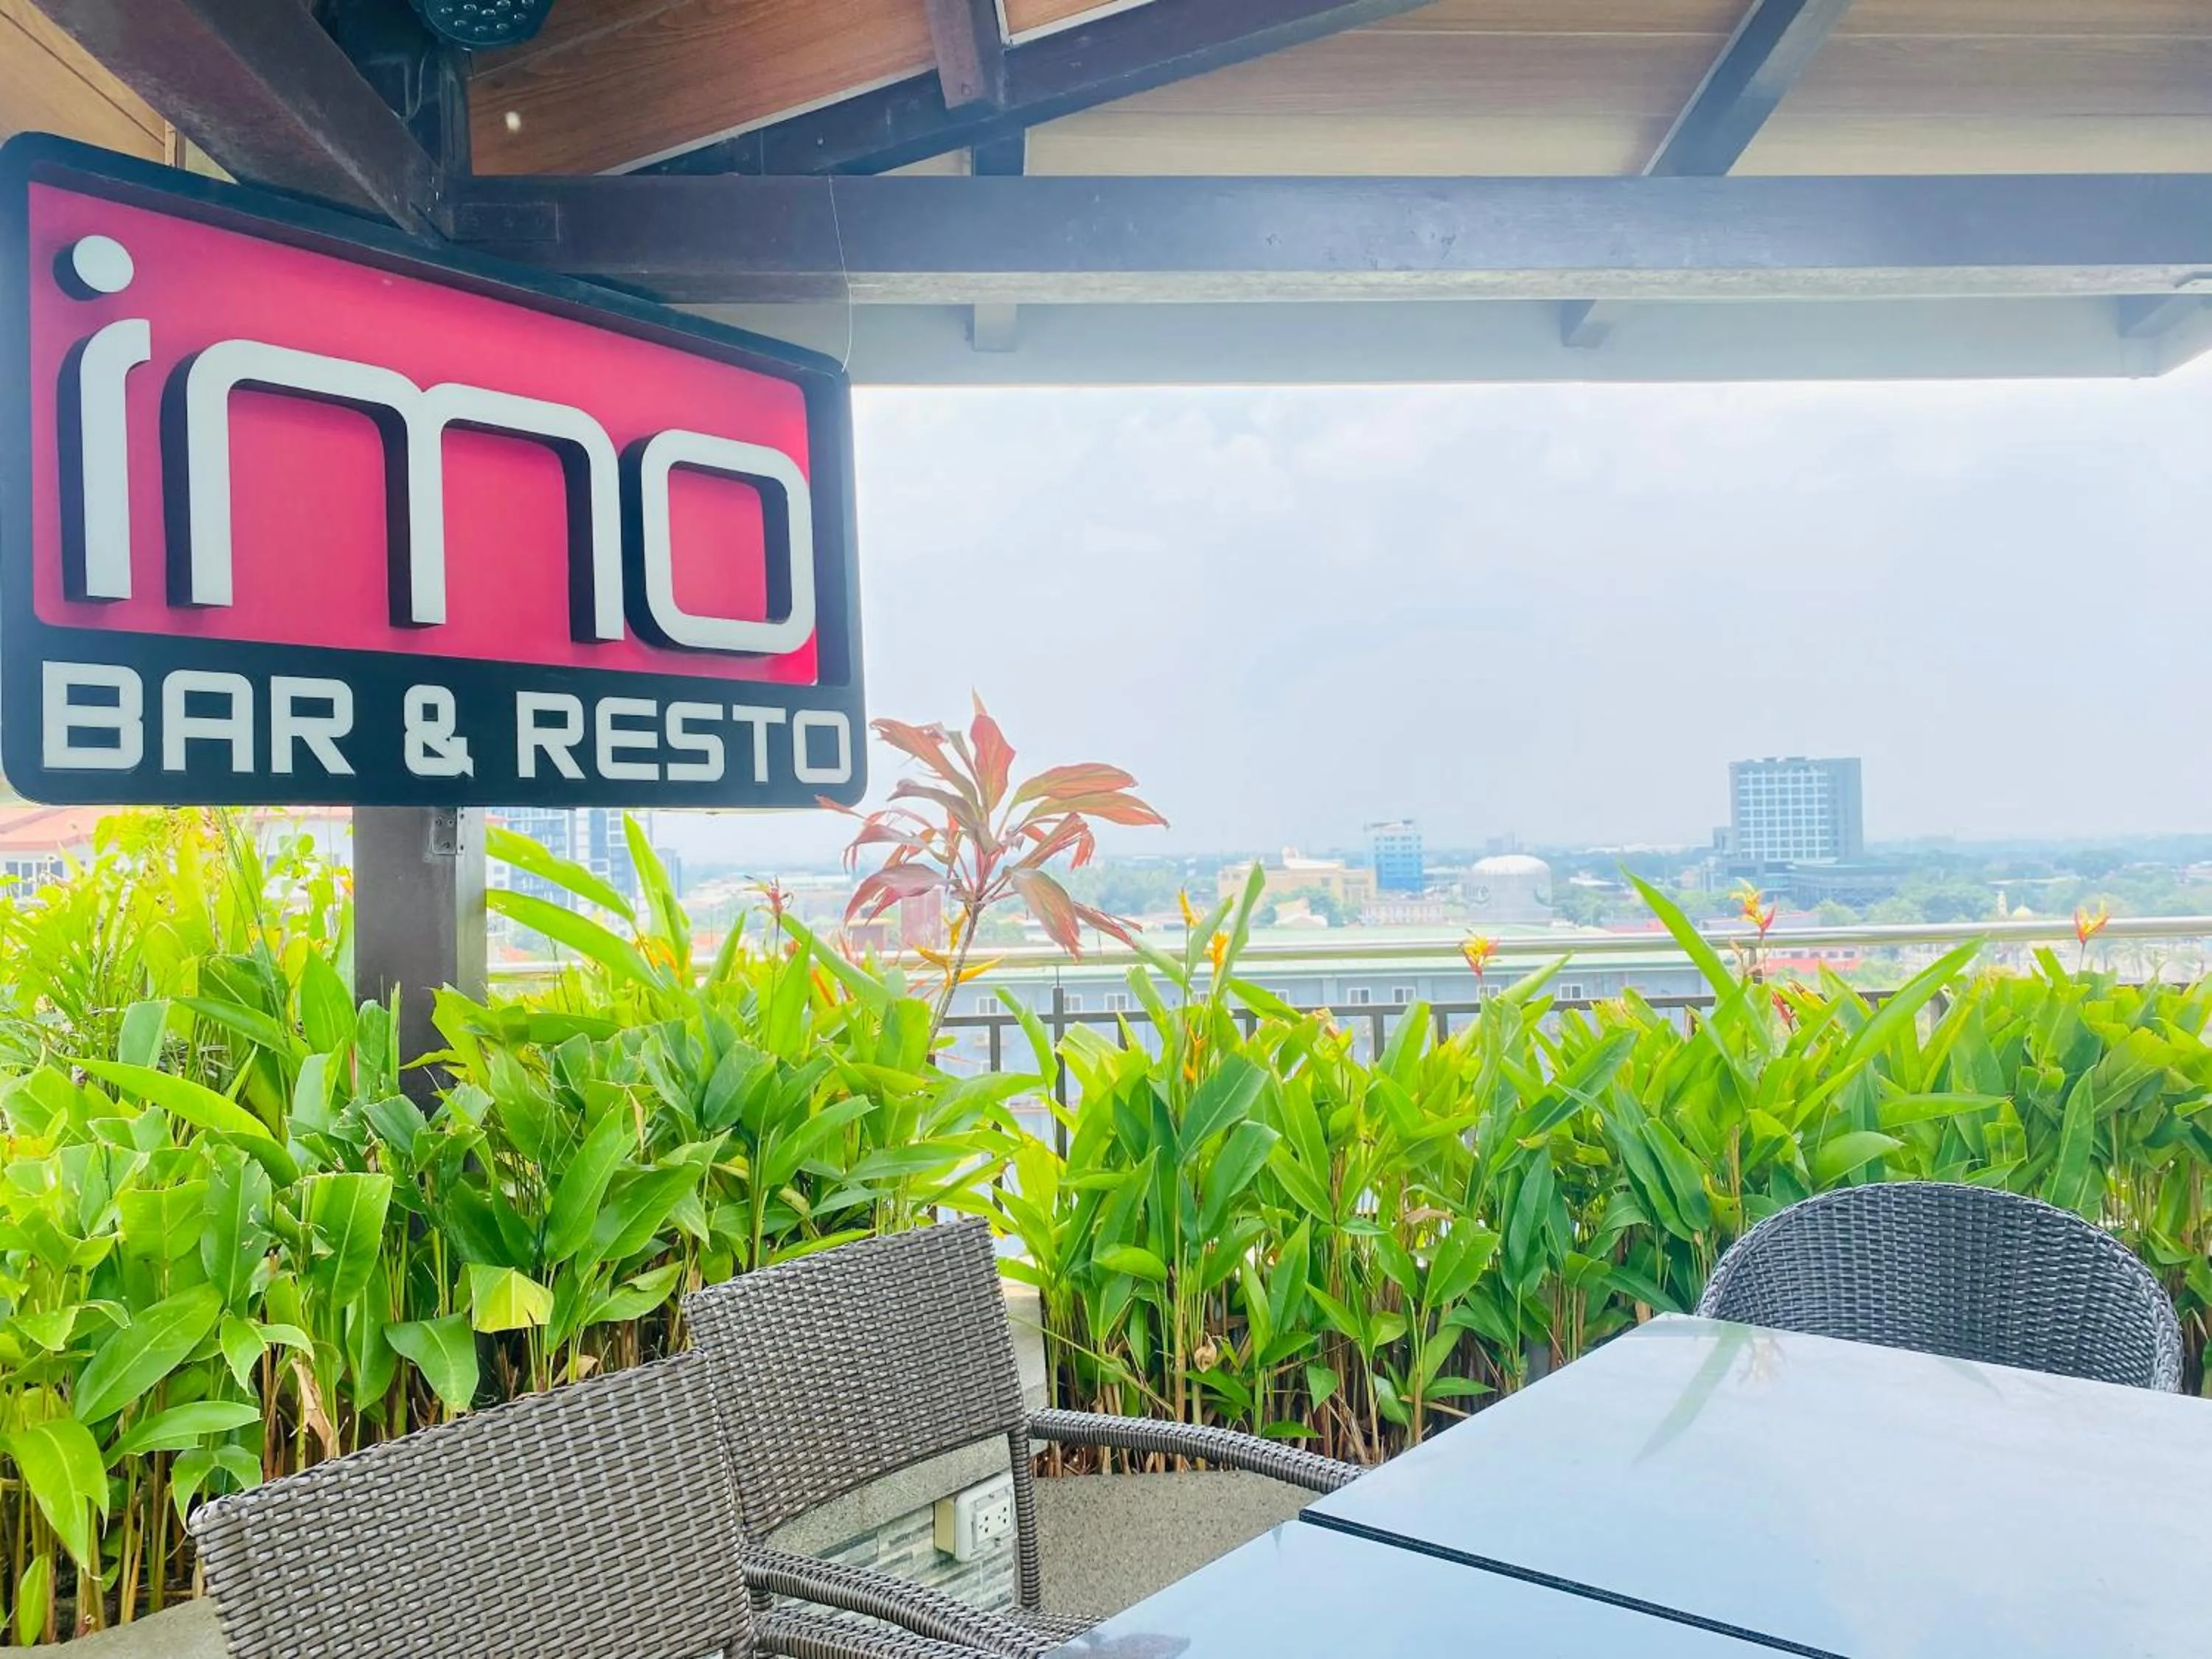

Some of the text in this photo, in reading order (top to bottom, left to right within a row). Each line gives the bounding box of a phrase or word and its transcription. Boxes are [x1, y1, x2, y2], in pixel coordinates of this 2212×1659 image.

[70, 234, 817, 655] imo
[41, 660, 852, 785] BAR & RESTO
